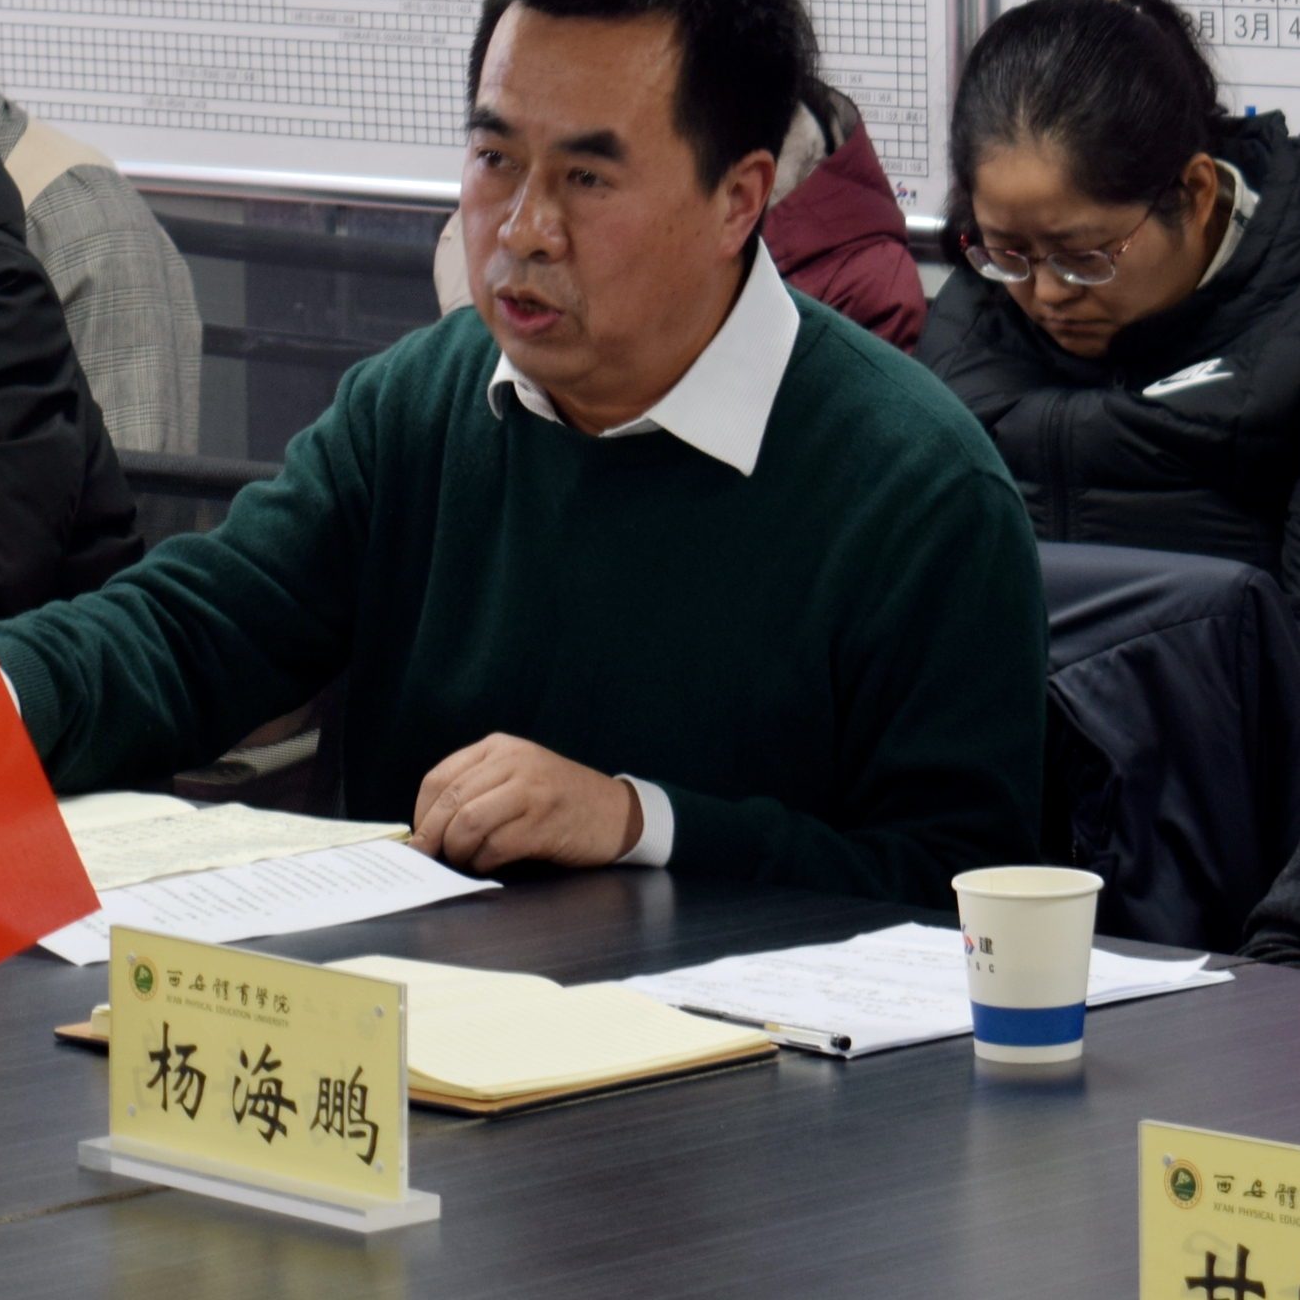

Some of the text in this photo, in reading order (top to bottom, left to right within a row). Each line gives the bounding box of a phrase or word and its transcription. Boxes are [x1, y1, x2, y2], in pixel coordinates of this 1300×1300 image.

[1234, 13, 1270, 41] 3月
[185, 998, 213, 1013] PHYSICAL
[216, 1005, 251, 1020] EDUCATION
[253, 1014, 289, 1027] UNIVERSITY
[146, 1021, 380, 1166] 杨海鹏
[1214, 1202, 1234, 1214] XI'AN
[1238, 1207, 1275, 1222] PHYSICAL
